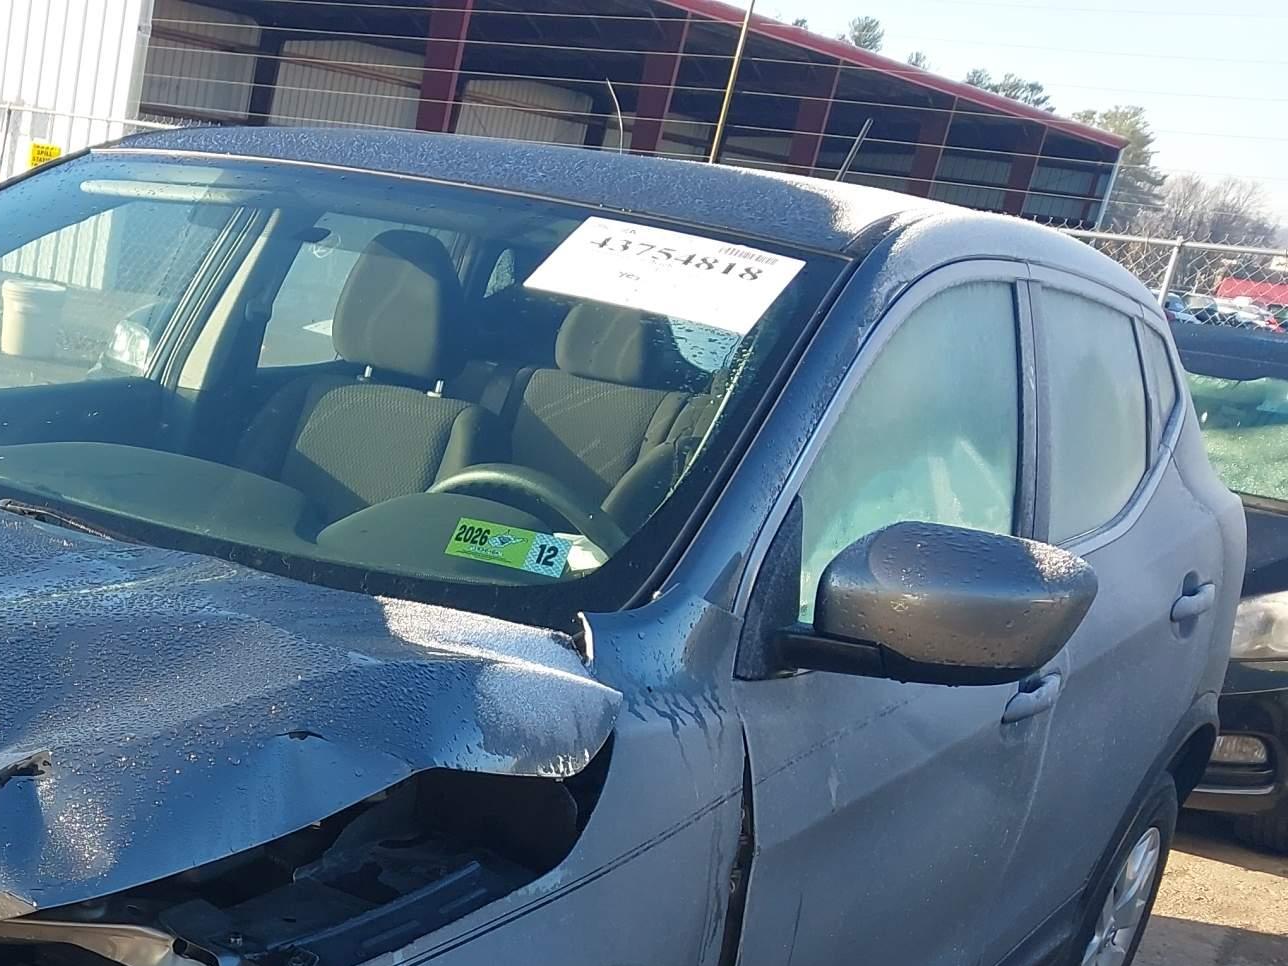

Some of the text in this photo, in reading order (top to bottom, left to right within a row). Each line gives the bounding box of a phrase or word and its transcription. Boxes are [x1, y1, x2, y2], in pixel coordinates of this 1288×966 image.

[590, 235, 764, 281] 43754818
[455, 525, 490, 546] 2026
[536, 544, 559, 567] 12
